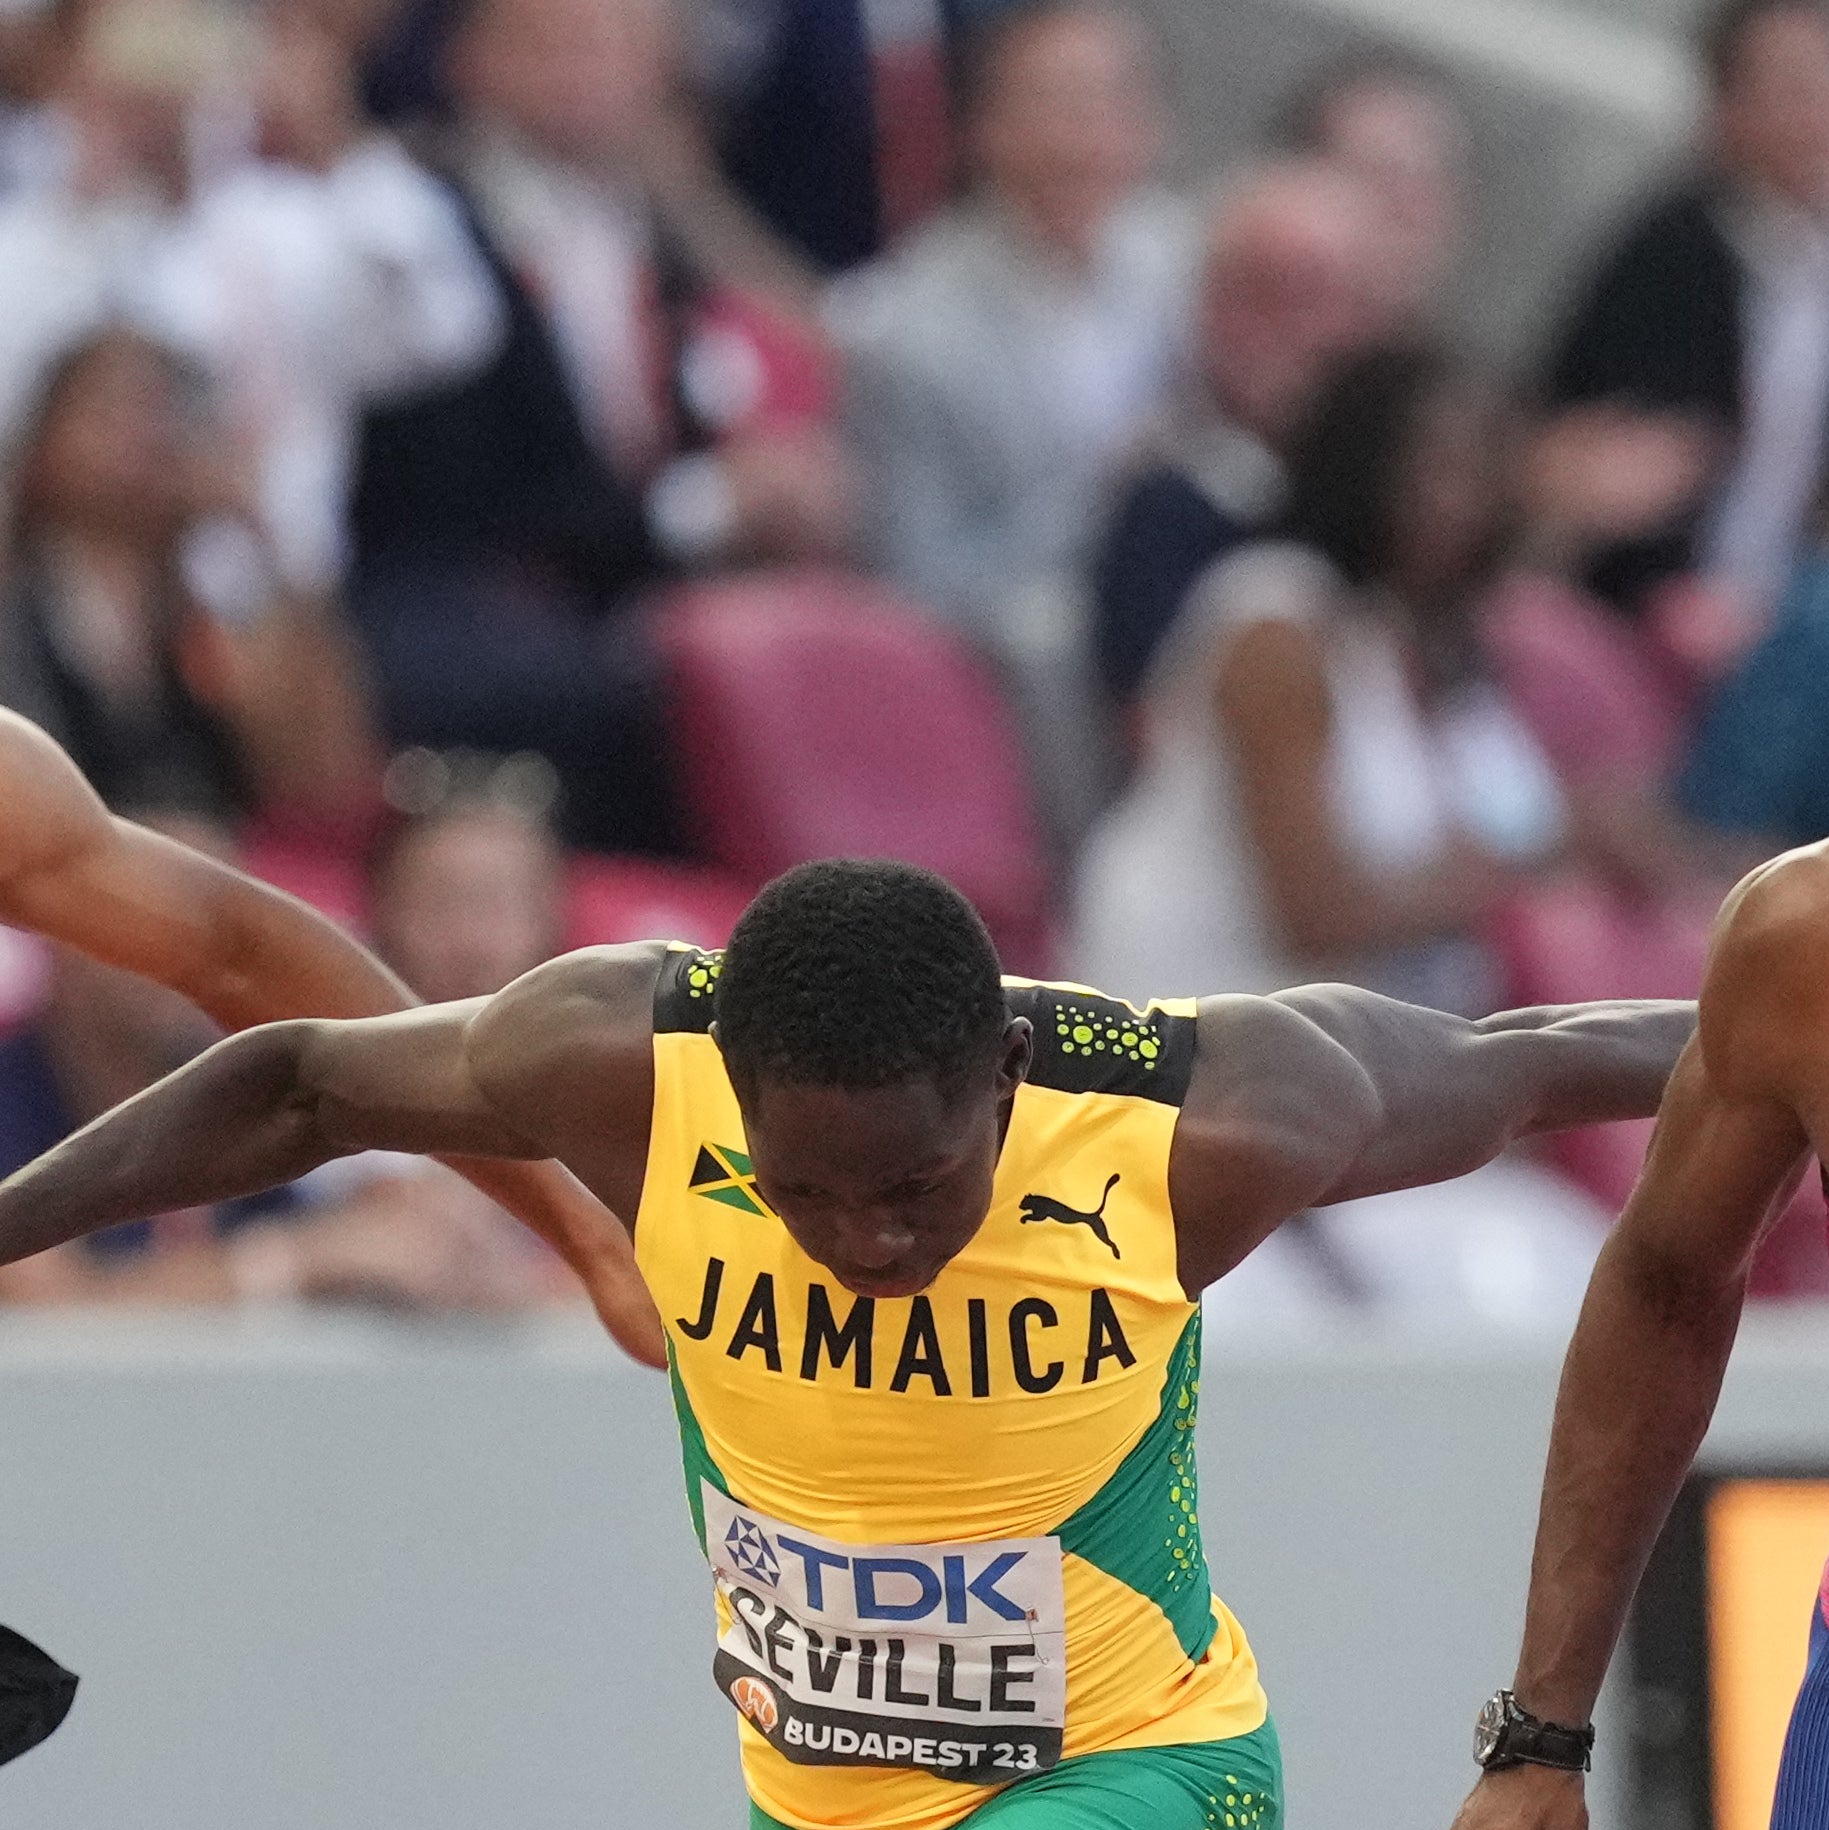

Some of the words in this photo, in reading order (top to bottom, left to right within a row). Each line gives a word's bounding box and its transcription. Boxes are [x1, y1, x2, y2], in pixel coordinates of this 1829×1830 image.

[676, 1256, 1138, 1398] JAMAICA
[776, 1533, 1029, 1624] TDK
[728, 1586, 1037, 1713] SEVILLE
[783, 1718, 990, 1768] BUDAPEST
[992, 1743, 1037, 1769] 23
